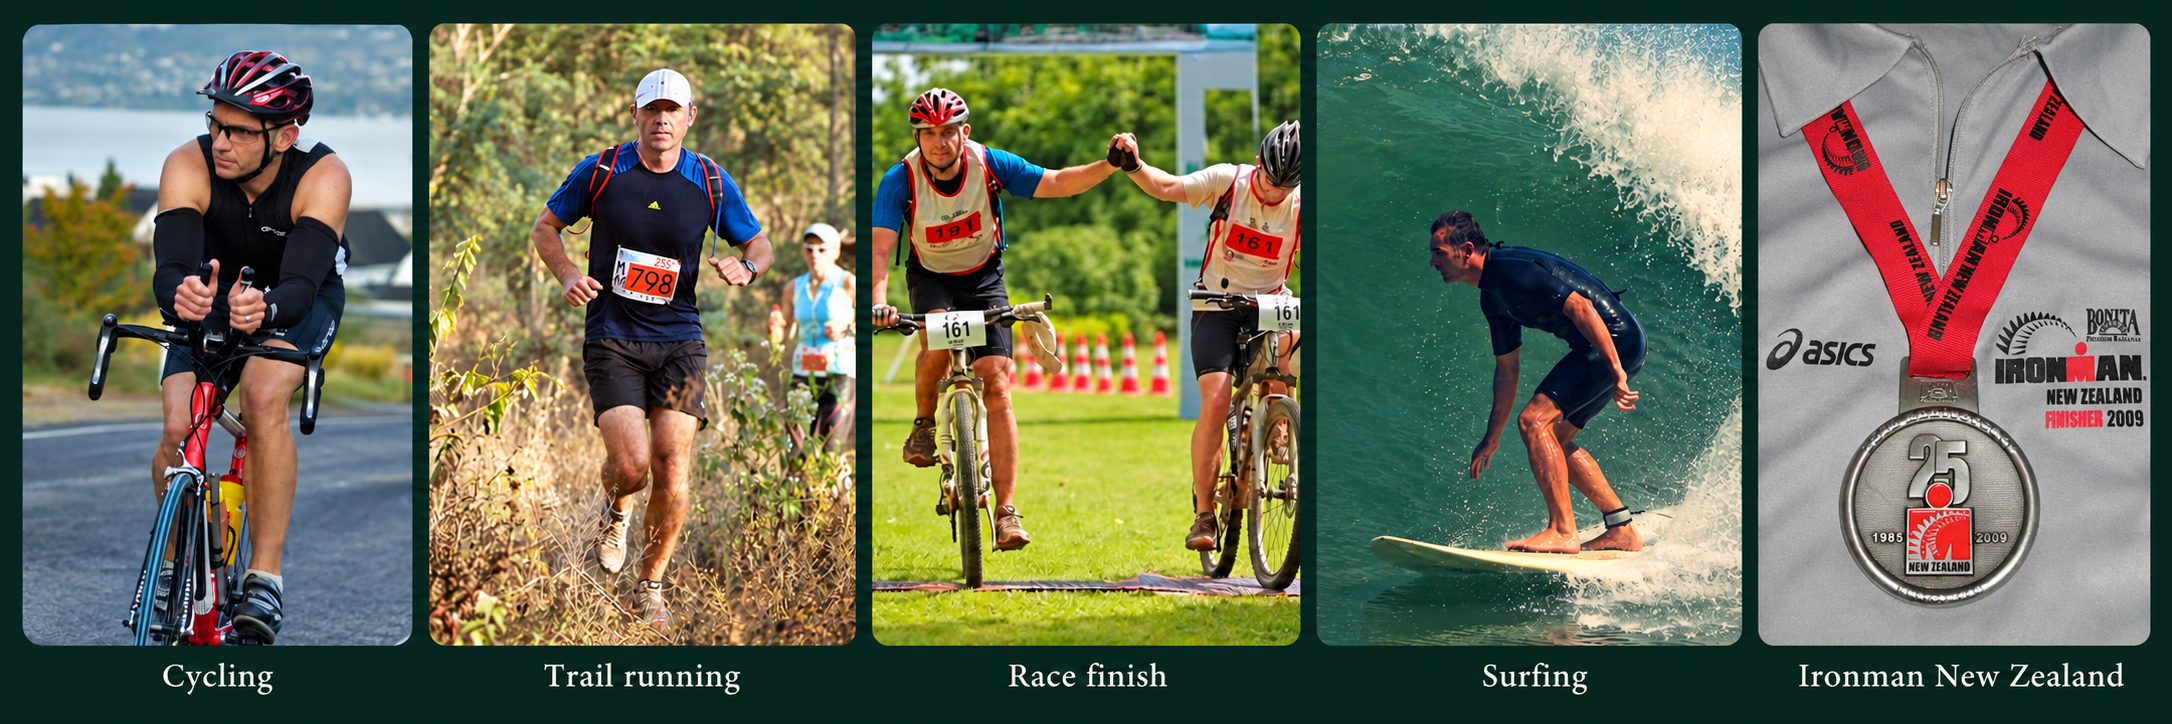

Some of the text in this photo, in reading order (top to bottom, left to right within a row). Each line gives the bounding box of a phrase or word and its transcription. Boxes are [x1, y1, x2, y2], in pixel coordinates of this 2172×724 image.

[1830, 104, 1871, 172] IRONMA
[1964, 188, 2014, 267] IRONMAN
[1236, 232, 1273, 253] 161
[1889, 219, 1926, 271] ZEALAND
[630, 266, 673, 295] 798
[1951, 263, 1977, 294] NEW
[1274, 305, 1300, 321] 161
[1927, 289, 1962, 342] ZEALAND
[2086, 308, 2141, 336] BONITA
[942, 321, 970, 339] 161
[2046, 387, 2143, 405] NEW ZEALAND
[2045, 409, 2144, 429] FINISHER 2009
[1908, 433, 1971, 505] 25
[1975, 532, 2008, 543] 2009
[1908, 561, 1971, 572] NEW ZEALAND
